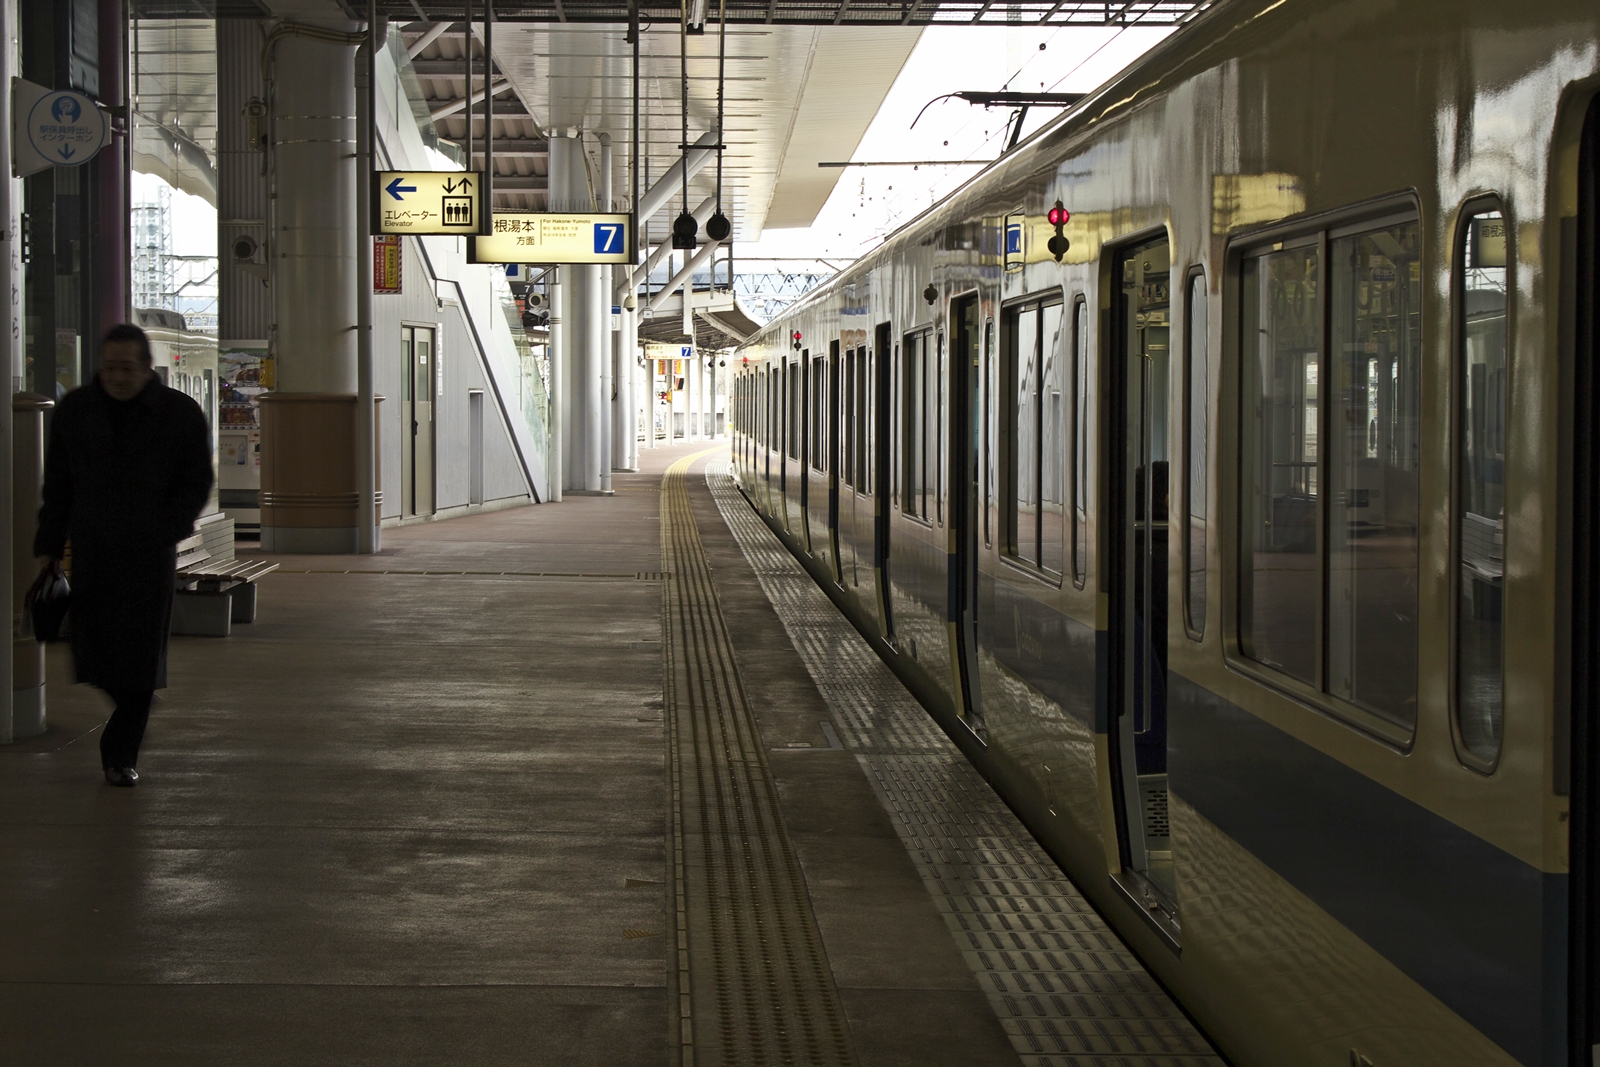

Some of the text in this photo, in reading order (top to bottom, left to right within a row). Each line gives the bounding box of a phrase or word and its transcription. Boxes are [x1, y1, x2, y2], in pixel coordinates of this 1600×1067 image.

[40, 134, 93, 143] インターホン
[385, 210, 437, 220] エレベーター
[491, 219, 535, 233] 根湯本
[516, 236, 535, 246] 方面
[600, 225, 617, 252] 7
[524, 285, 531, 293] 7
[683, 347, 690, 357] 7
